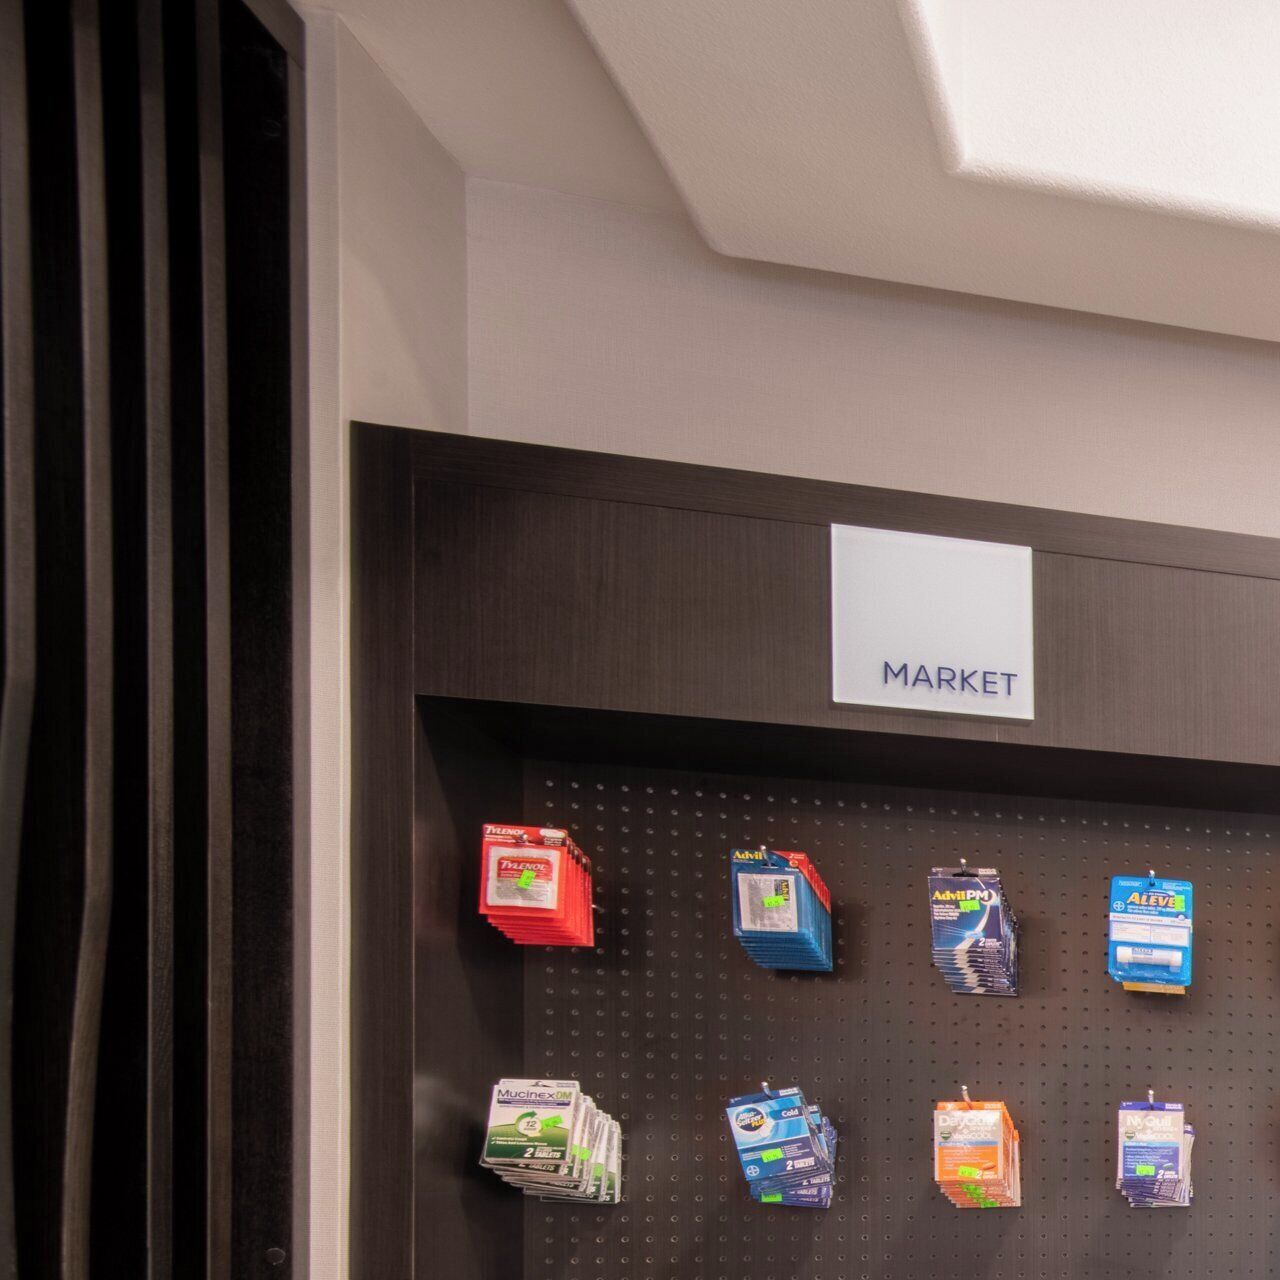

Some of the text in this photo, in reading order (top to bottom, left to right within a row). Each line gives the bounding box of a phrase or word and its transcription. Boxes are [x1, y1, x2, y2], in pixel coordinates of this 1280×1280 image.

[883, 660, 1019, 697] MARKET
[733, 850, 763, 860] Advil
[501, 861, 547, 873] TYLENOL
[933, 889, 965, 901] Advil
[1127, 891, 1178, 907] ALEVE
[498, 1088, 555, 1101] Mucinex
[781, 1108, 799, 1117] Cold
[786, 1160, 793, 1170] 2
